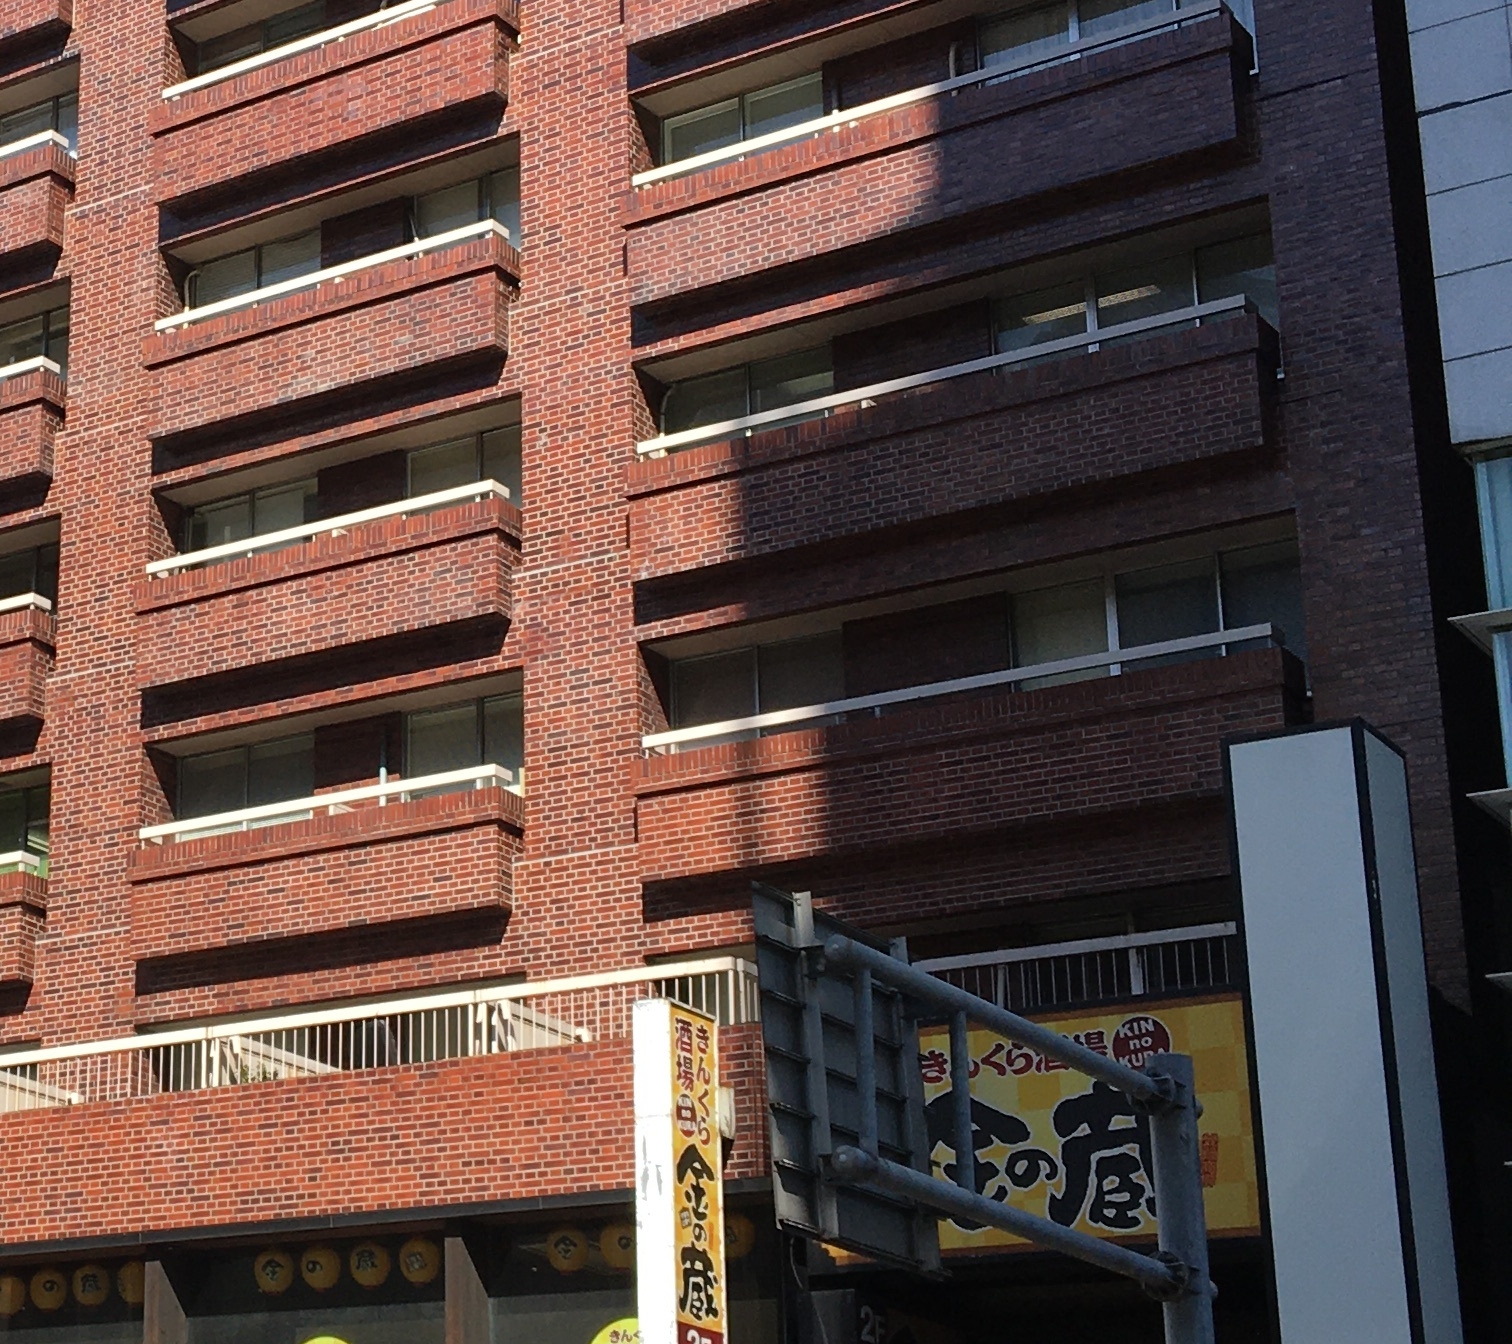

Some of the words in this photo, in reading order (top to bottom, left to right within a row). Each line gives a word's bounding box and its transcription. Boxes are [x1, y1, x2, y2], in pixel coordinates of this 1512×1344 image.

[1118, 1017, 1156, 1039] KIN
[1129, 1036, 1153, 1051] no
[674, 1016, 695, 1093] 酒場
[695, 1023, 712, 1147] きんくら
[676, 1143, 719, 1322] 金の蔵
[609, 1328, 639, 1343] きんく
